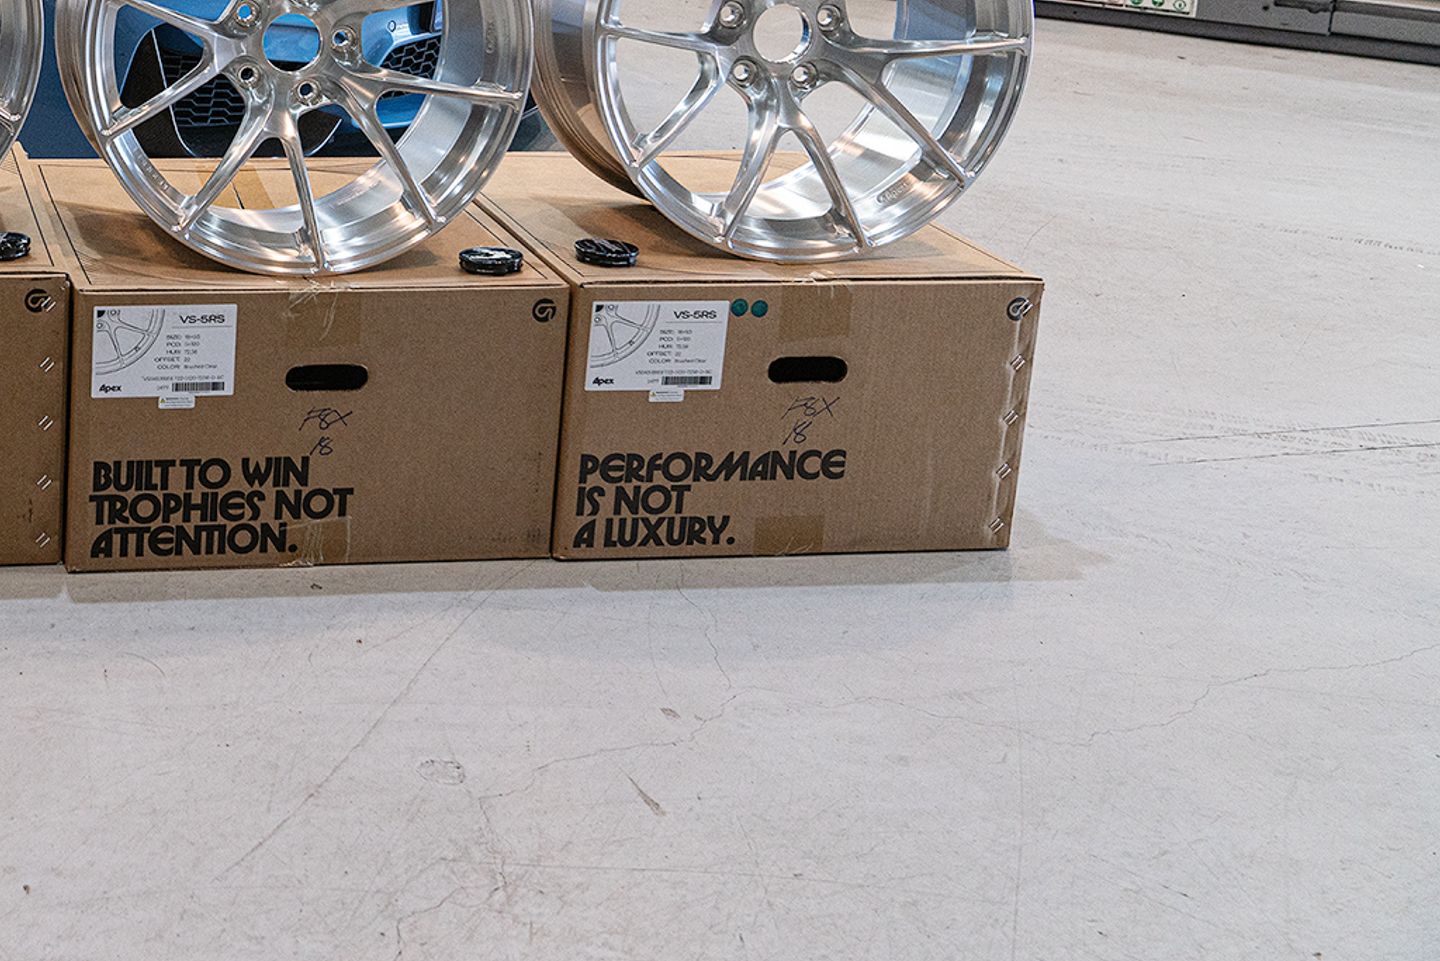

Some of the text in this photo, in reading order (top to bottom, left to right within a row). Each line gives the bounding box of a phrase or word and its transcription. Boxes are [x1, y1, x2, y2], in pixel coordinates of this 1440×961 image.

[179, 314, 225, 324] VS-5RS
[674, 310, 717, 320] VS-5RS
[99, 384, 122, 394] Apex
[592, 376, 614, 386] Apex
[782, 419, 810, 445] 18
[92, 456, 310, 493] BUILT TO WIN
[579, 448, 847, 485] PERFORMANCE
[89, 488, 354, 526] TROPHIES NOT
[576, 484, 691, 517] IS NOT
[90, 522, 298, 558] ATTENTION.
[572, 515, 736, 548] A LUXURY.
